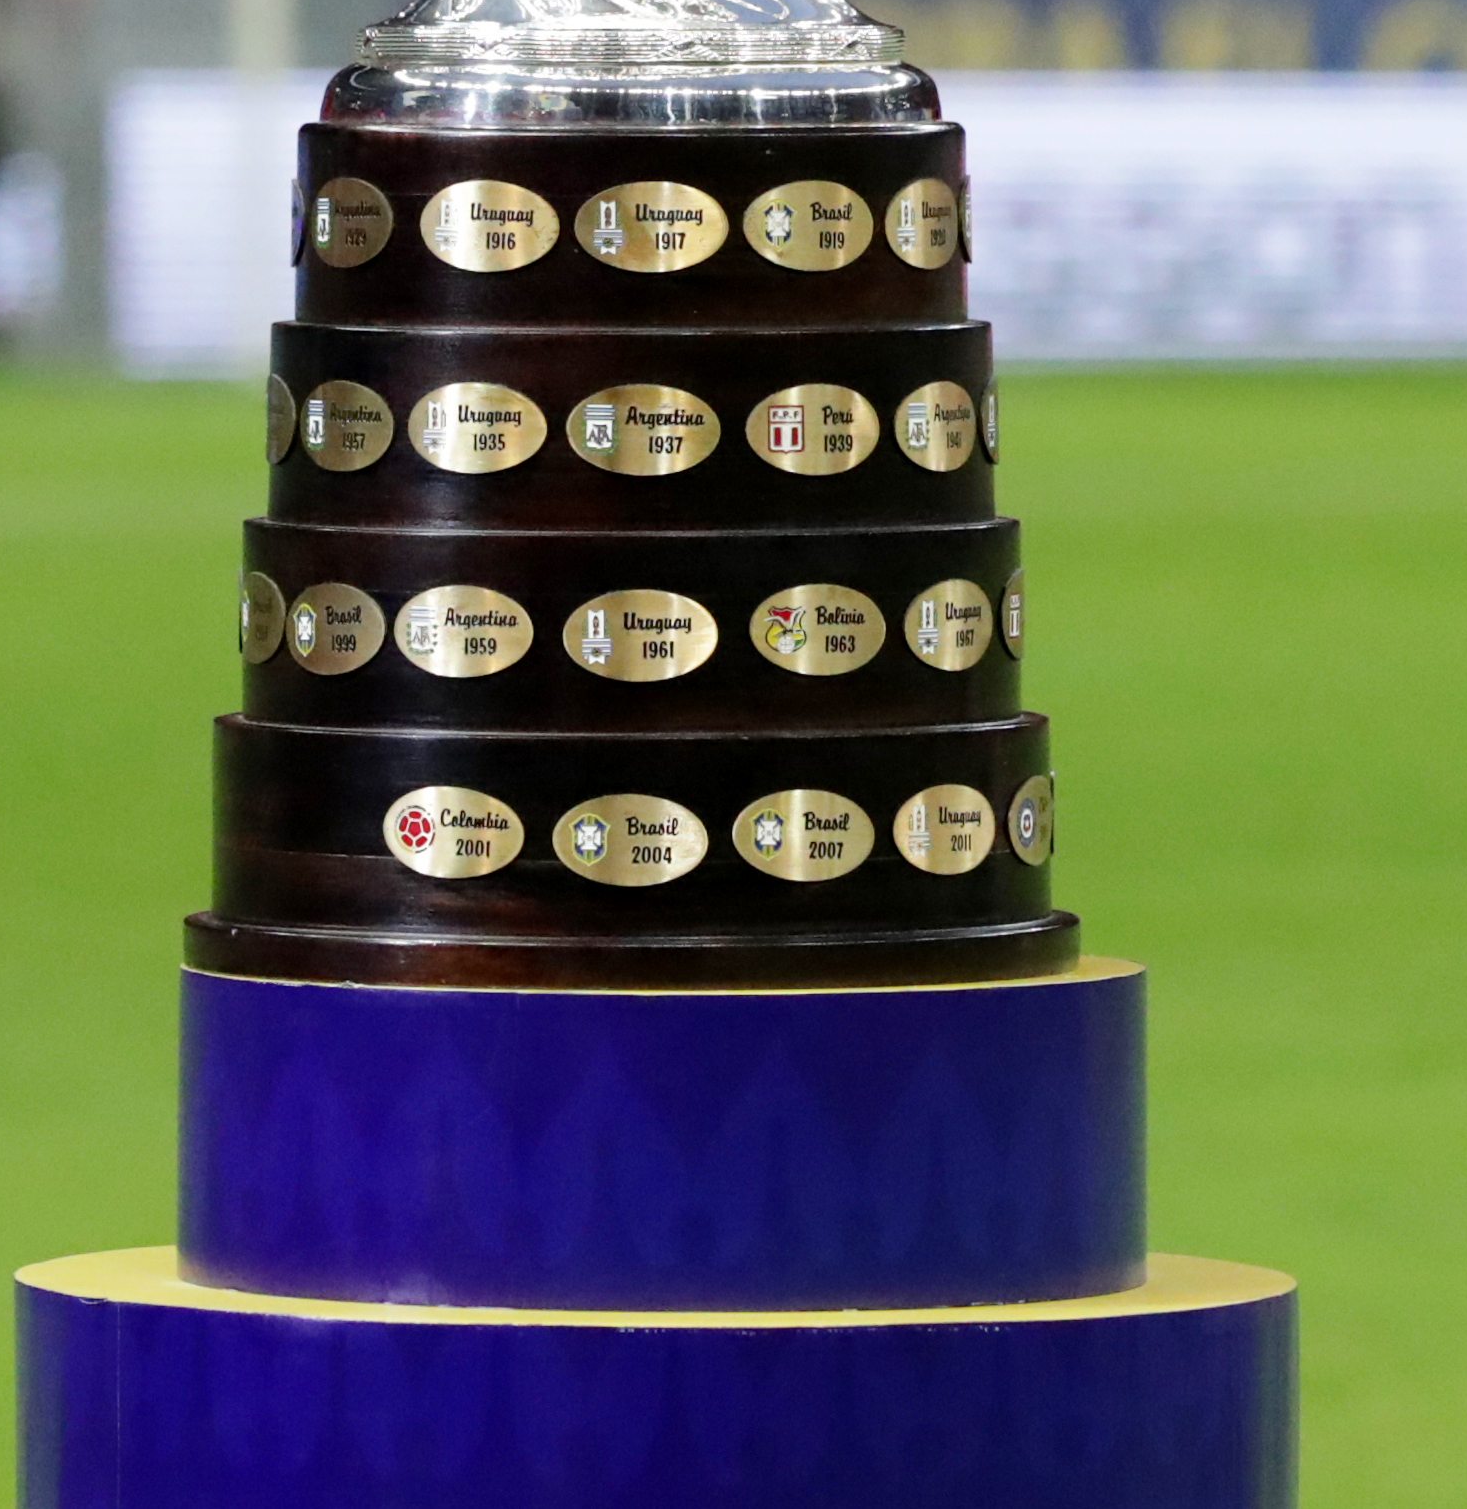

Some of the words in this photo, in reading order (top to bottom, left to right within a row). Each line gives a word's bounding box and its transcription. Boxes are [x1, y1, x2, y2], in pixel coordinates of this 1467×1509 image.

[470, 202, 535, 227] Uruguay
[635, 203, 703, 226] Uruguay
[809, 201, 853, 222] Brasil
[485, 231, 517, 250] 1916
[655, 232, 686, 250] 1917
[819, 231, 845, 250] 1919
[458, 404, 522, 427] Uruguay
[625, 406, 706, 430] Argentina
[473, 433, 506, 452] 1935
[648, 436, 683, 454] 1937
[824, 434, 854, 452] 1939
[324, 605, 362, 626] Brasil
[444, 607, 519, 630] Argentina
[623, 611, 692, 635] Uruguay
[815, 605, 866, 626] Bolivia
[945, 602, 982, 624] Uruguay
[331, 634, 357, 653] 1999
[463, 637, 497, 656] 1959
[825, 635, 856, 653] 1963
[955, 628, 975, 648] 1967
[643, 640, 674, 659] 1961
[440, 808, 510, 832] Colombia
[625, 816, 680, 836] Brasil
[802, 811, 850, 831] Brasil
[938, 805, 982, 828] Uruguay
[455, 838, 491, 858] 2001
[809, 841, 844, 860] 2007
[950, 834, 972, 852] 2011
[631, 846, 673, 865] 2004
